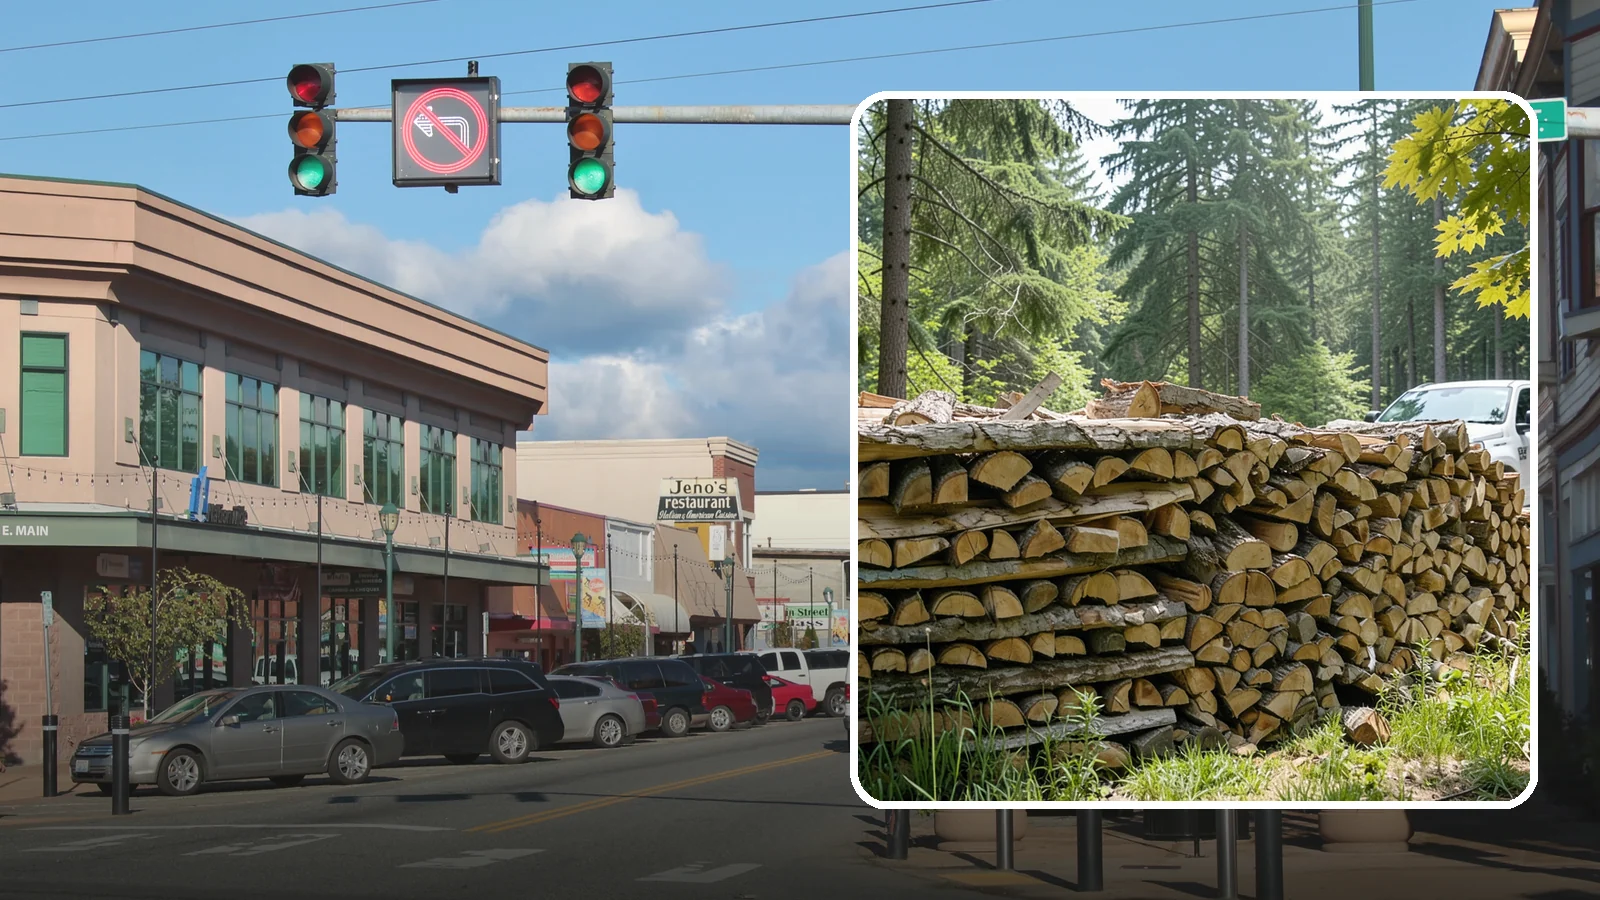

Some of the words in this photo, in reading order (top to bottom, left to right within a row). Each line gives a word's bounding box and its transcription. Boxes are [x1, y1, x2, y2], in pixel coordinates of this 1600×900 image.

[669, 480, 727, 494] Jeno's
[665, 496, 731, 509] restaurant
[659, 510, 681, 519] Italian
[686, 510, 714, 519] American
[715, 509, 737, 519] Cuisine
[2, 525, 13, 536] E.
[15, 525, 49, 536] MAIN
[797, 607, 828, 617] Street
